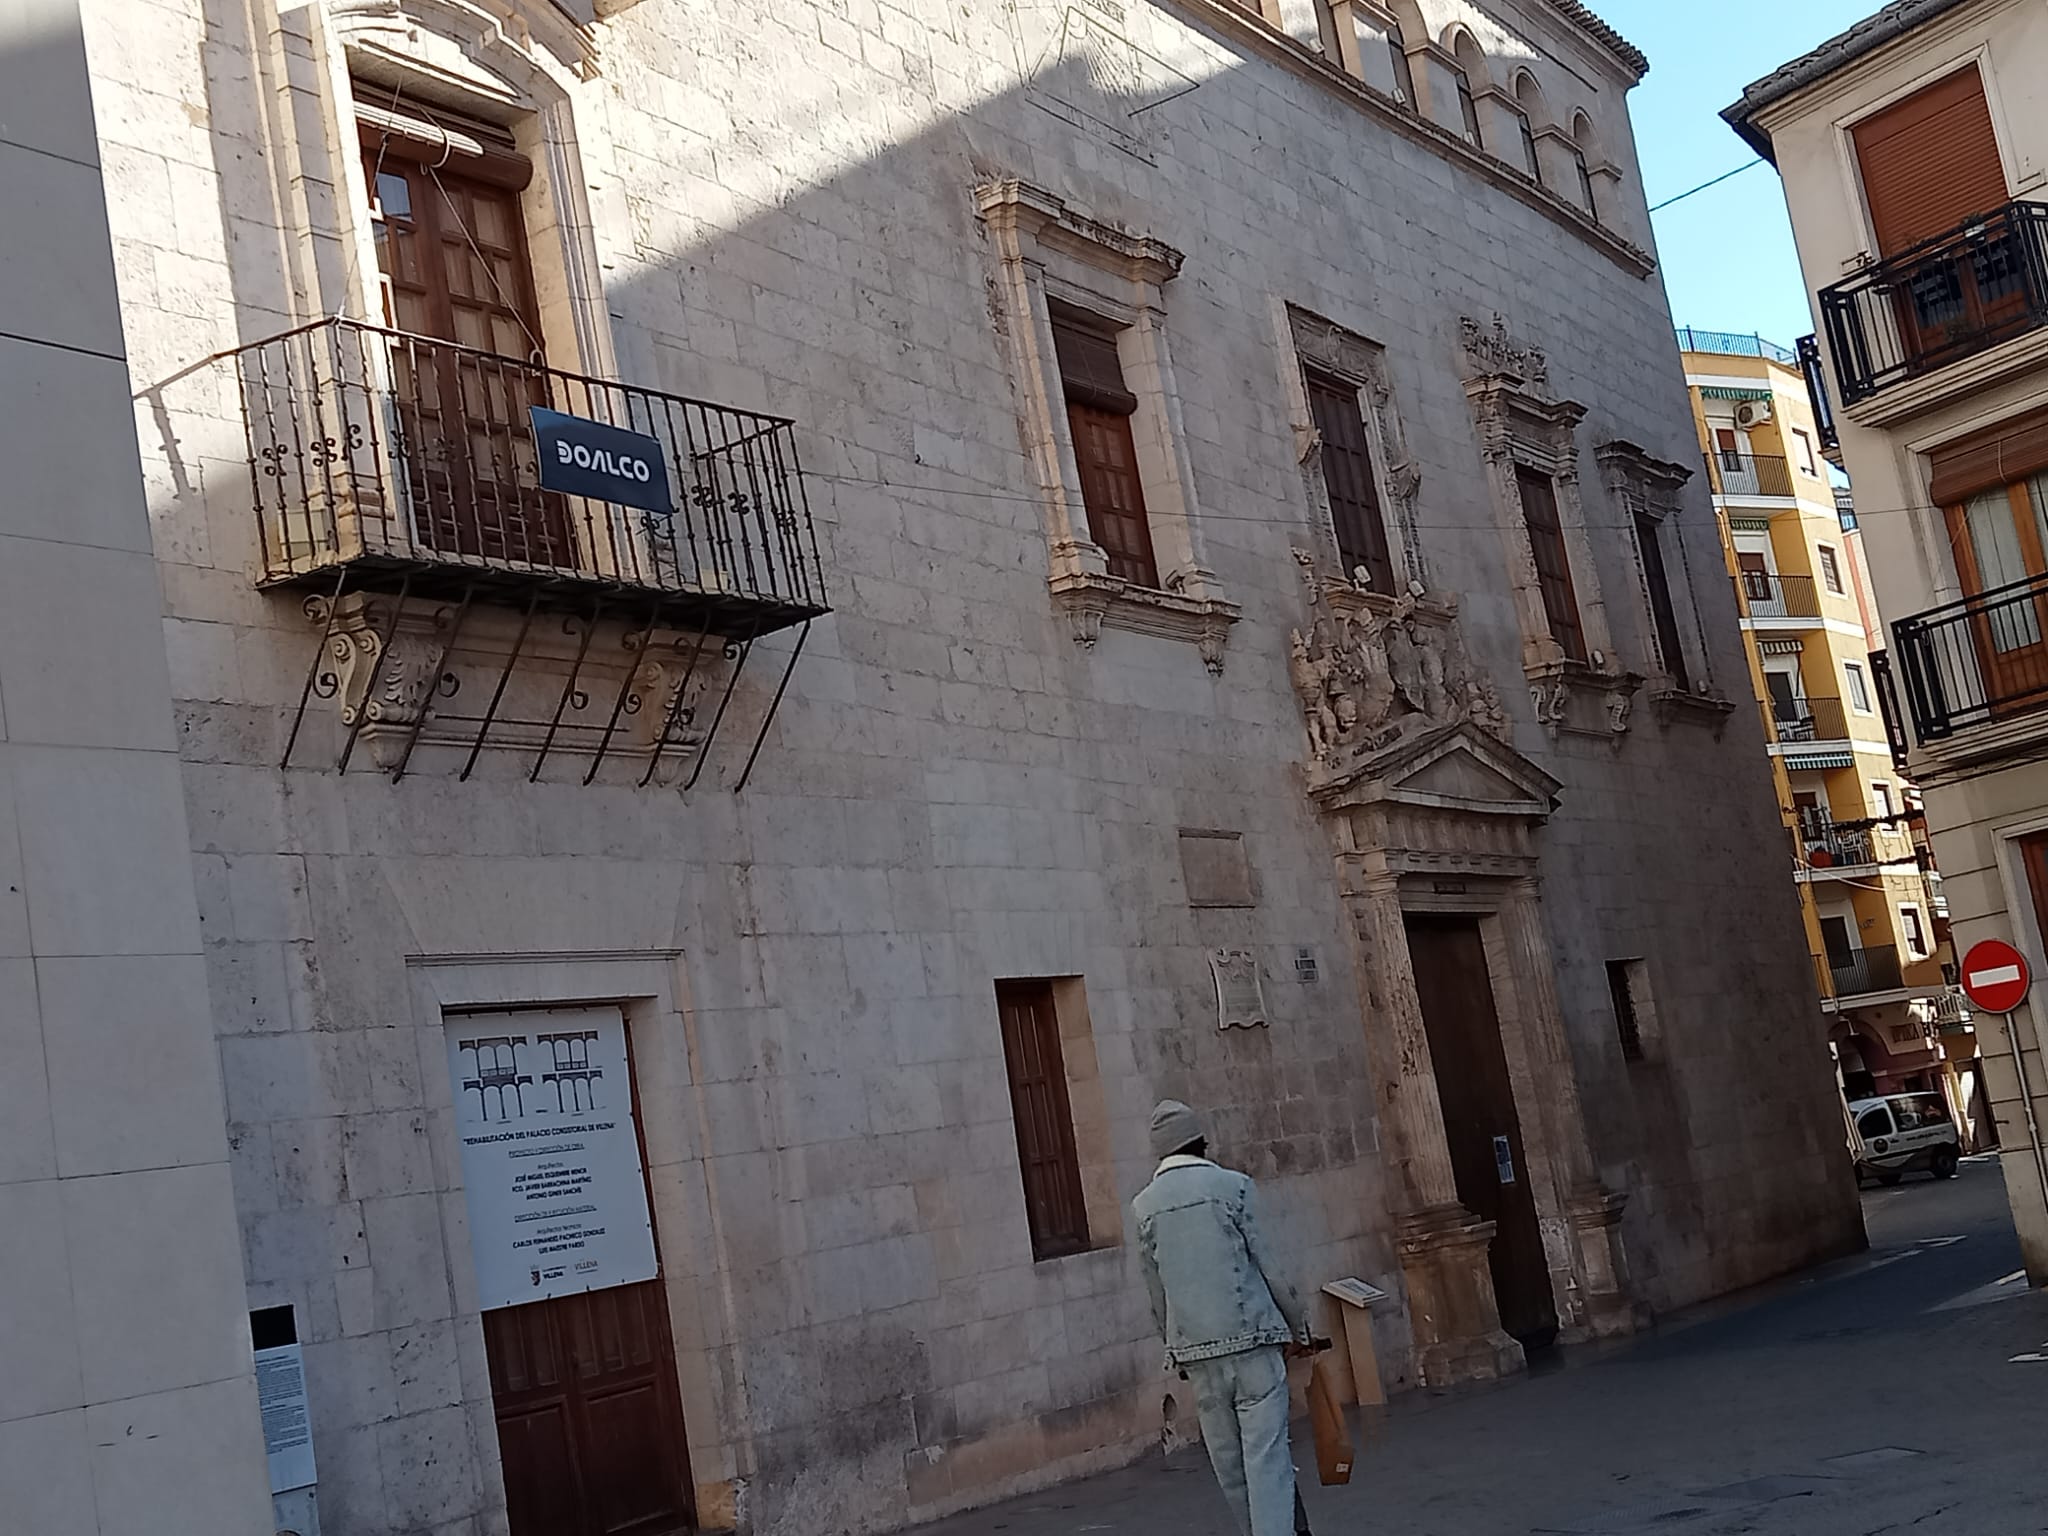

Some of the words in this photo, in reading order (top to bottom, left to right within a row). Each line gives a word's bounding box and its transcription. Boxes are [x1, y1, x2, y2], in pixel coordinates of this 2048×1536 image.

[556, 440, 650, 482] DOALCO
[515, 1131, 526, 1140] DEL
[526, 1128, 551, 1138] PALACIO
[551, 1125, 588, 1136] CONSISTORIAL
[588, 1123, 595, 1132] DE
